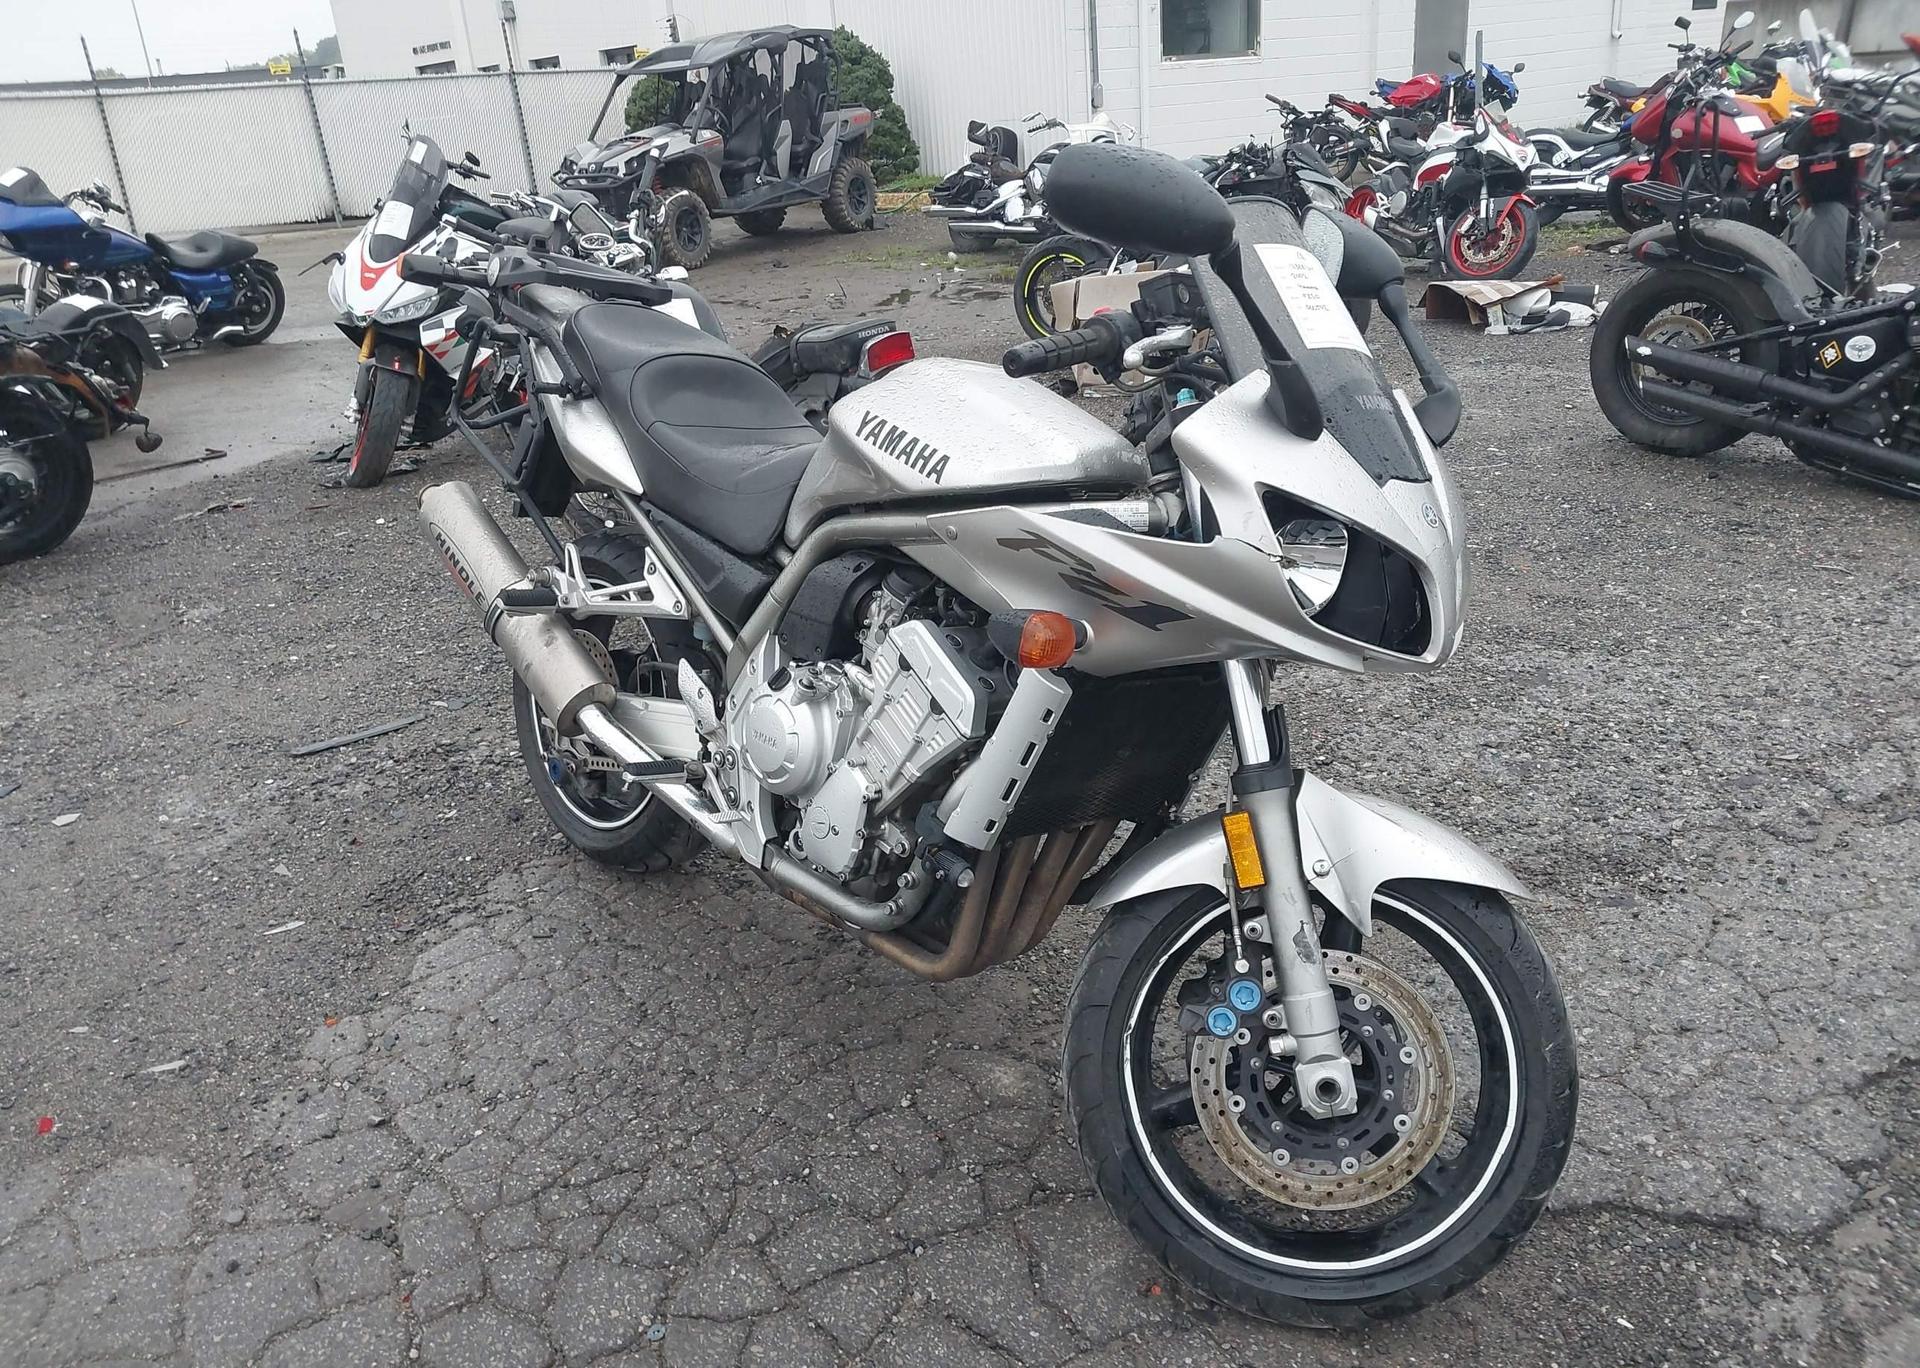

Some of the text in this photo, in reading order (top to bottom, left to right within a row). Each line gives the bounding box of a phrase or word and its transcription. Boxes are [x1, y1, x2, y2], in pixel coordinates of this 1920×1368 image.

[858, 325, 890, 339] HONDA
[855, 410, 951, 485] YAMAHA
[435, 532, 486, 606] HINDLE
